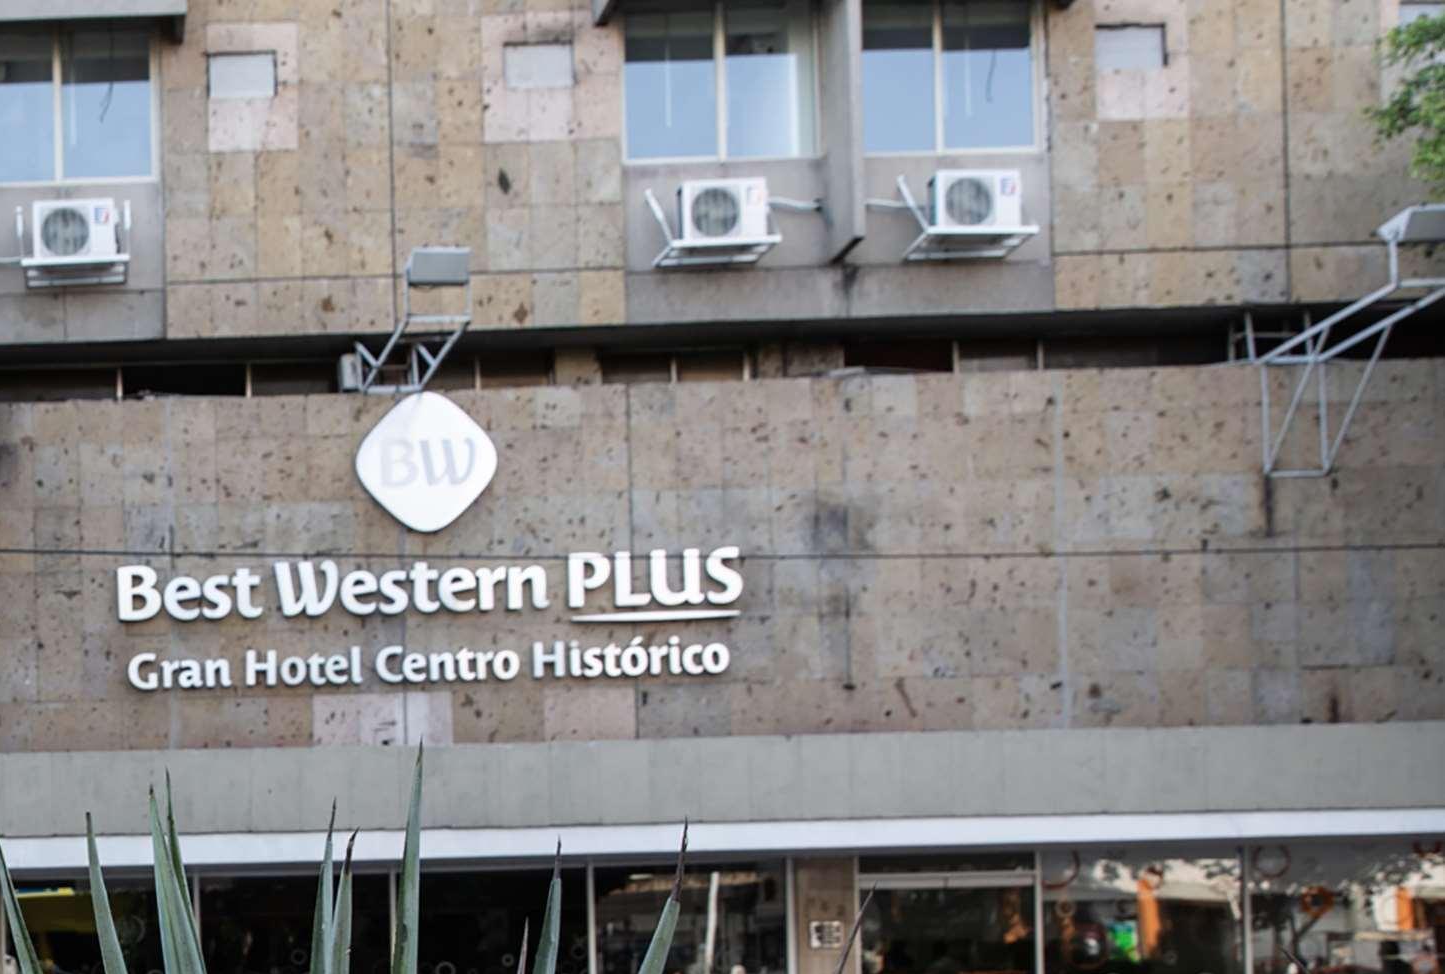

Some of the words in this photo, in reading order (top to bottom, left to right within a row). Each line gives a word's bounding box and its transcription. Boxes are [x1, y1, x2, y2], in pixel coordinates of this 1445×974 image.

[379, 436, 477, 488] BW
[117, 565, 263, 620] Best
[274, 560, 549, 615] Western
[568, 546, 743, 609] PLUS
[128, 652, 232, 689] Gran
[246, 647, 362, 686] Hotel
[376, 646, 521, 683] Centro
[533, 636, 730, 679] Histórico
